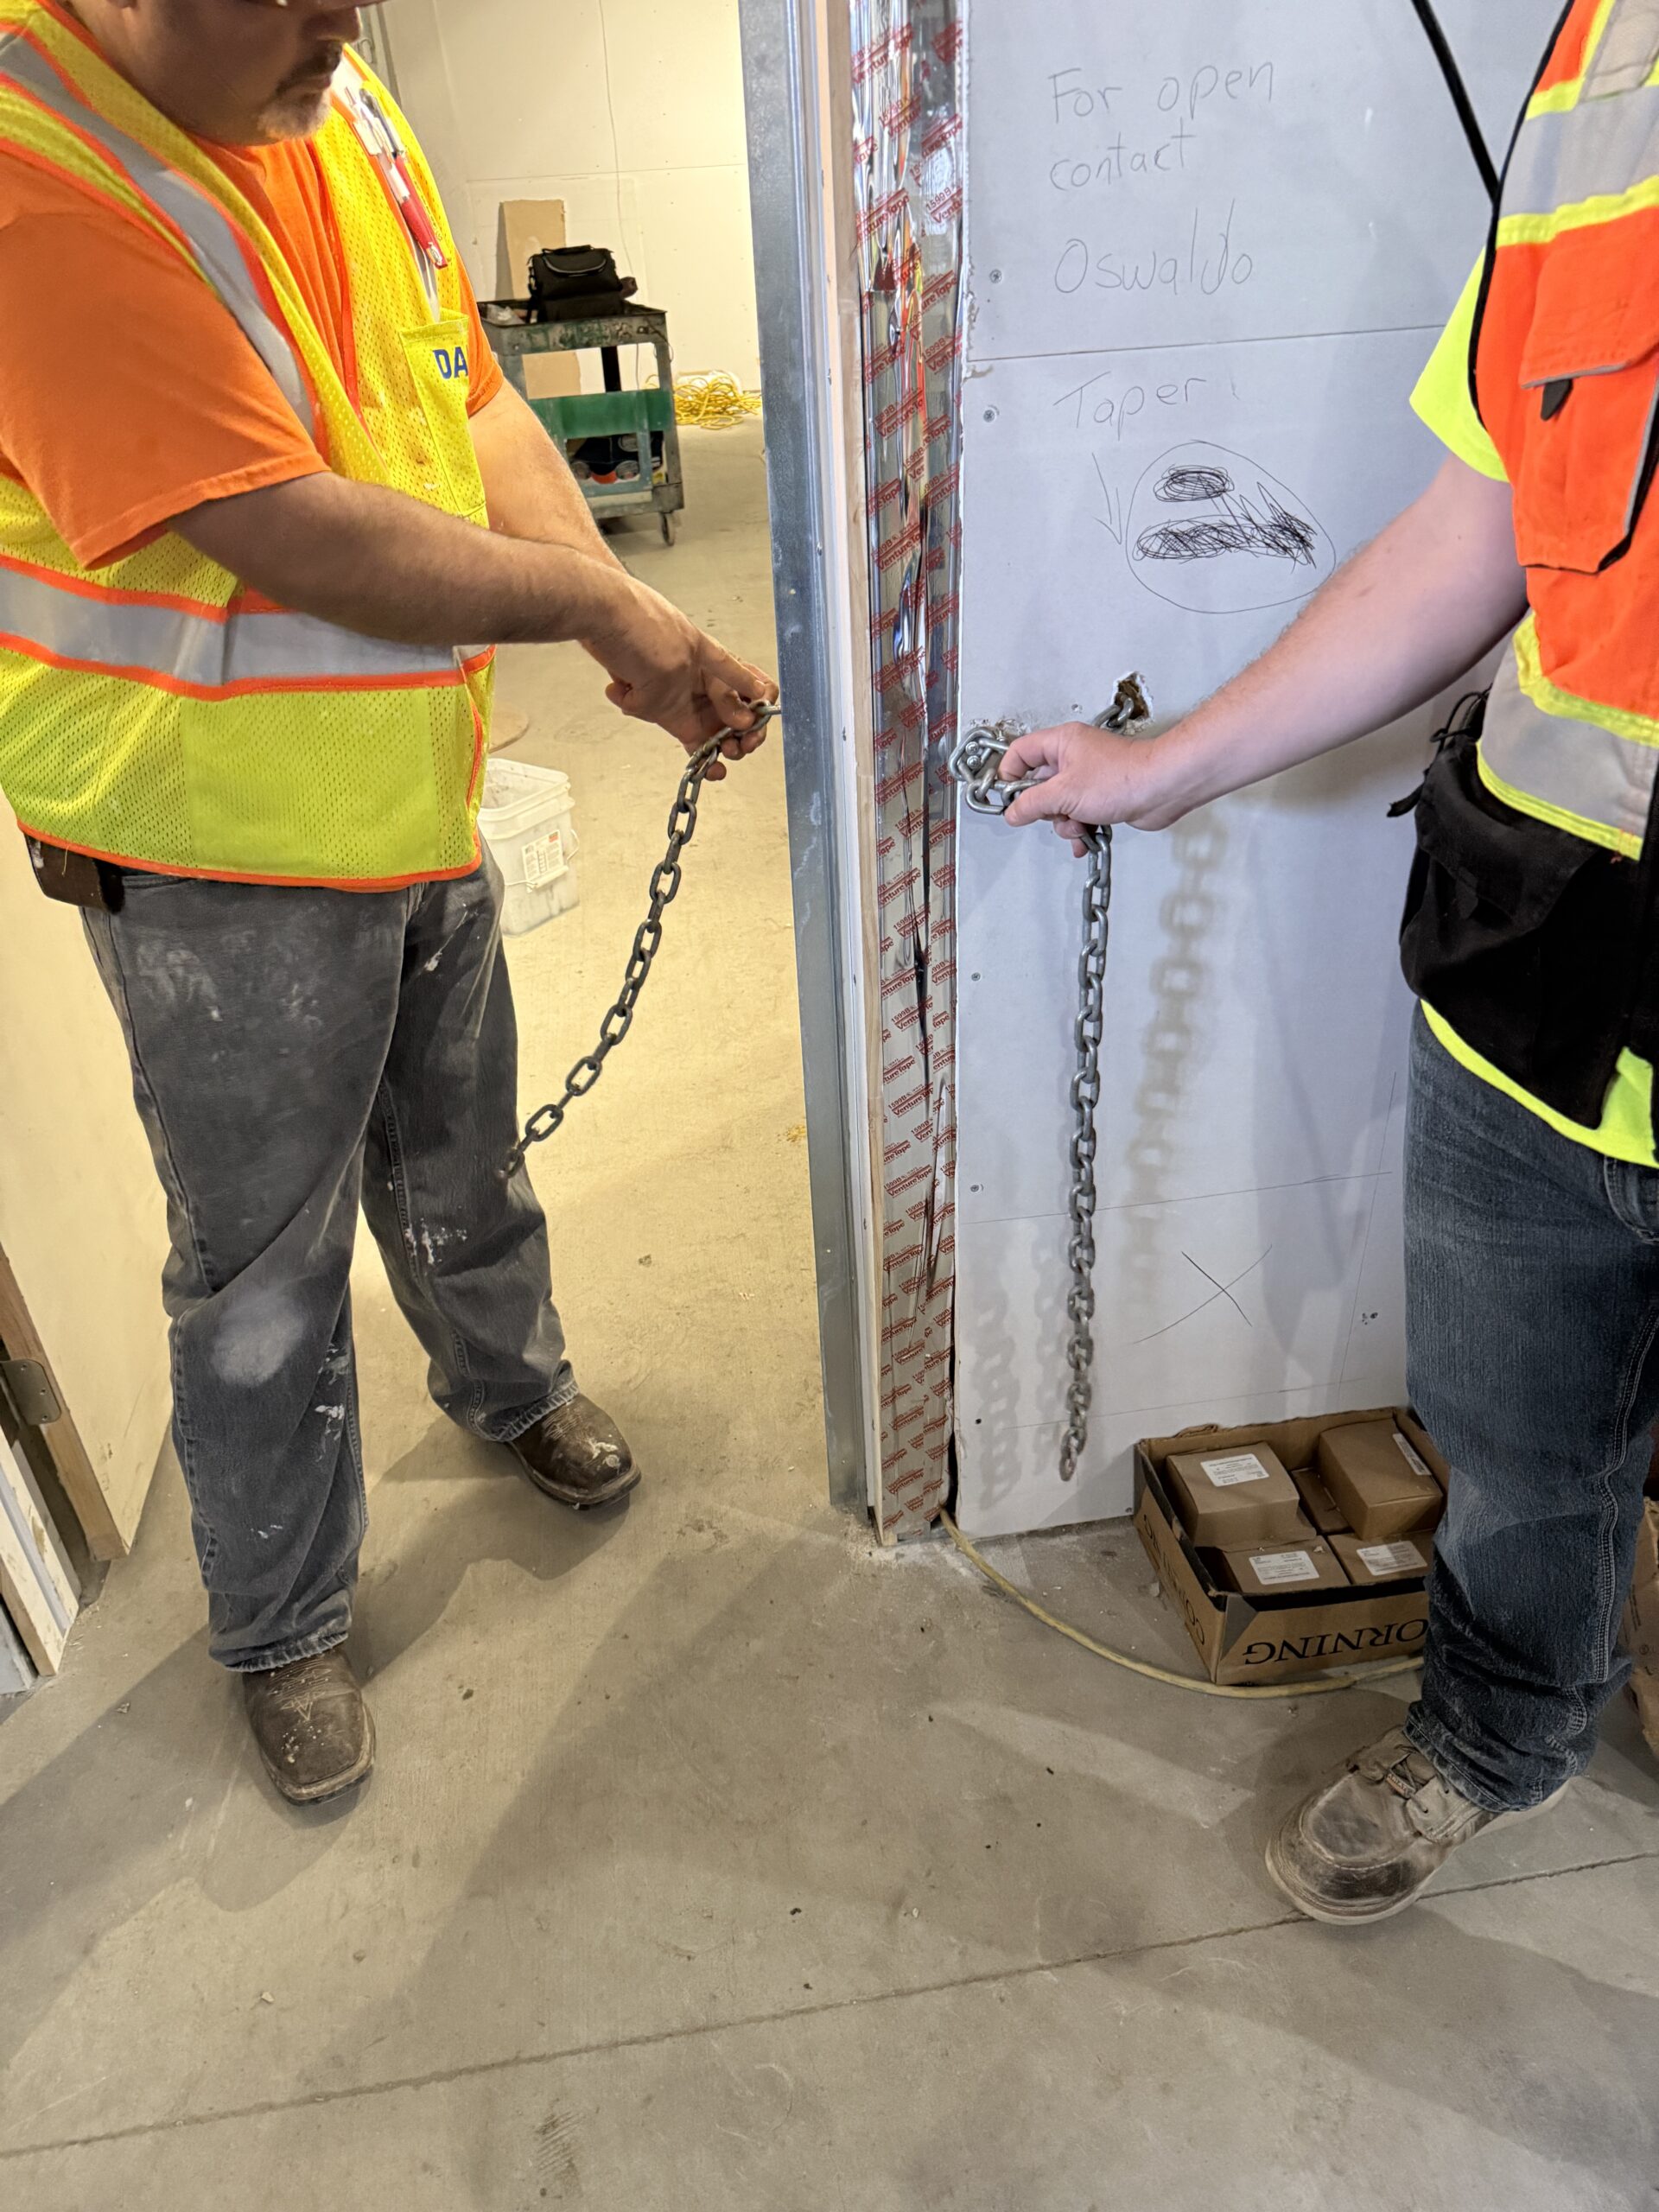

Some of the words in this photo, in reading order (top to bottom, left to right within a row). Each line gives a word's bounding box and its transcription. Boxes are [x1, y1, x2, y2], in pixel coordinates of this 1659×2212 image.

[1048, 67, 1122, 124] For
[1157, 61, 1274, 120] open
[1050, 117, 1197, 191] contact
[1054, 198, 1253, 295] Oswaldo
[889, 1167, 932, 1197] VentureTape
[1243, 1618, 1428, 1666] ORNING
